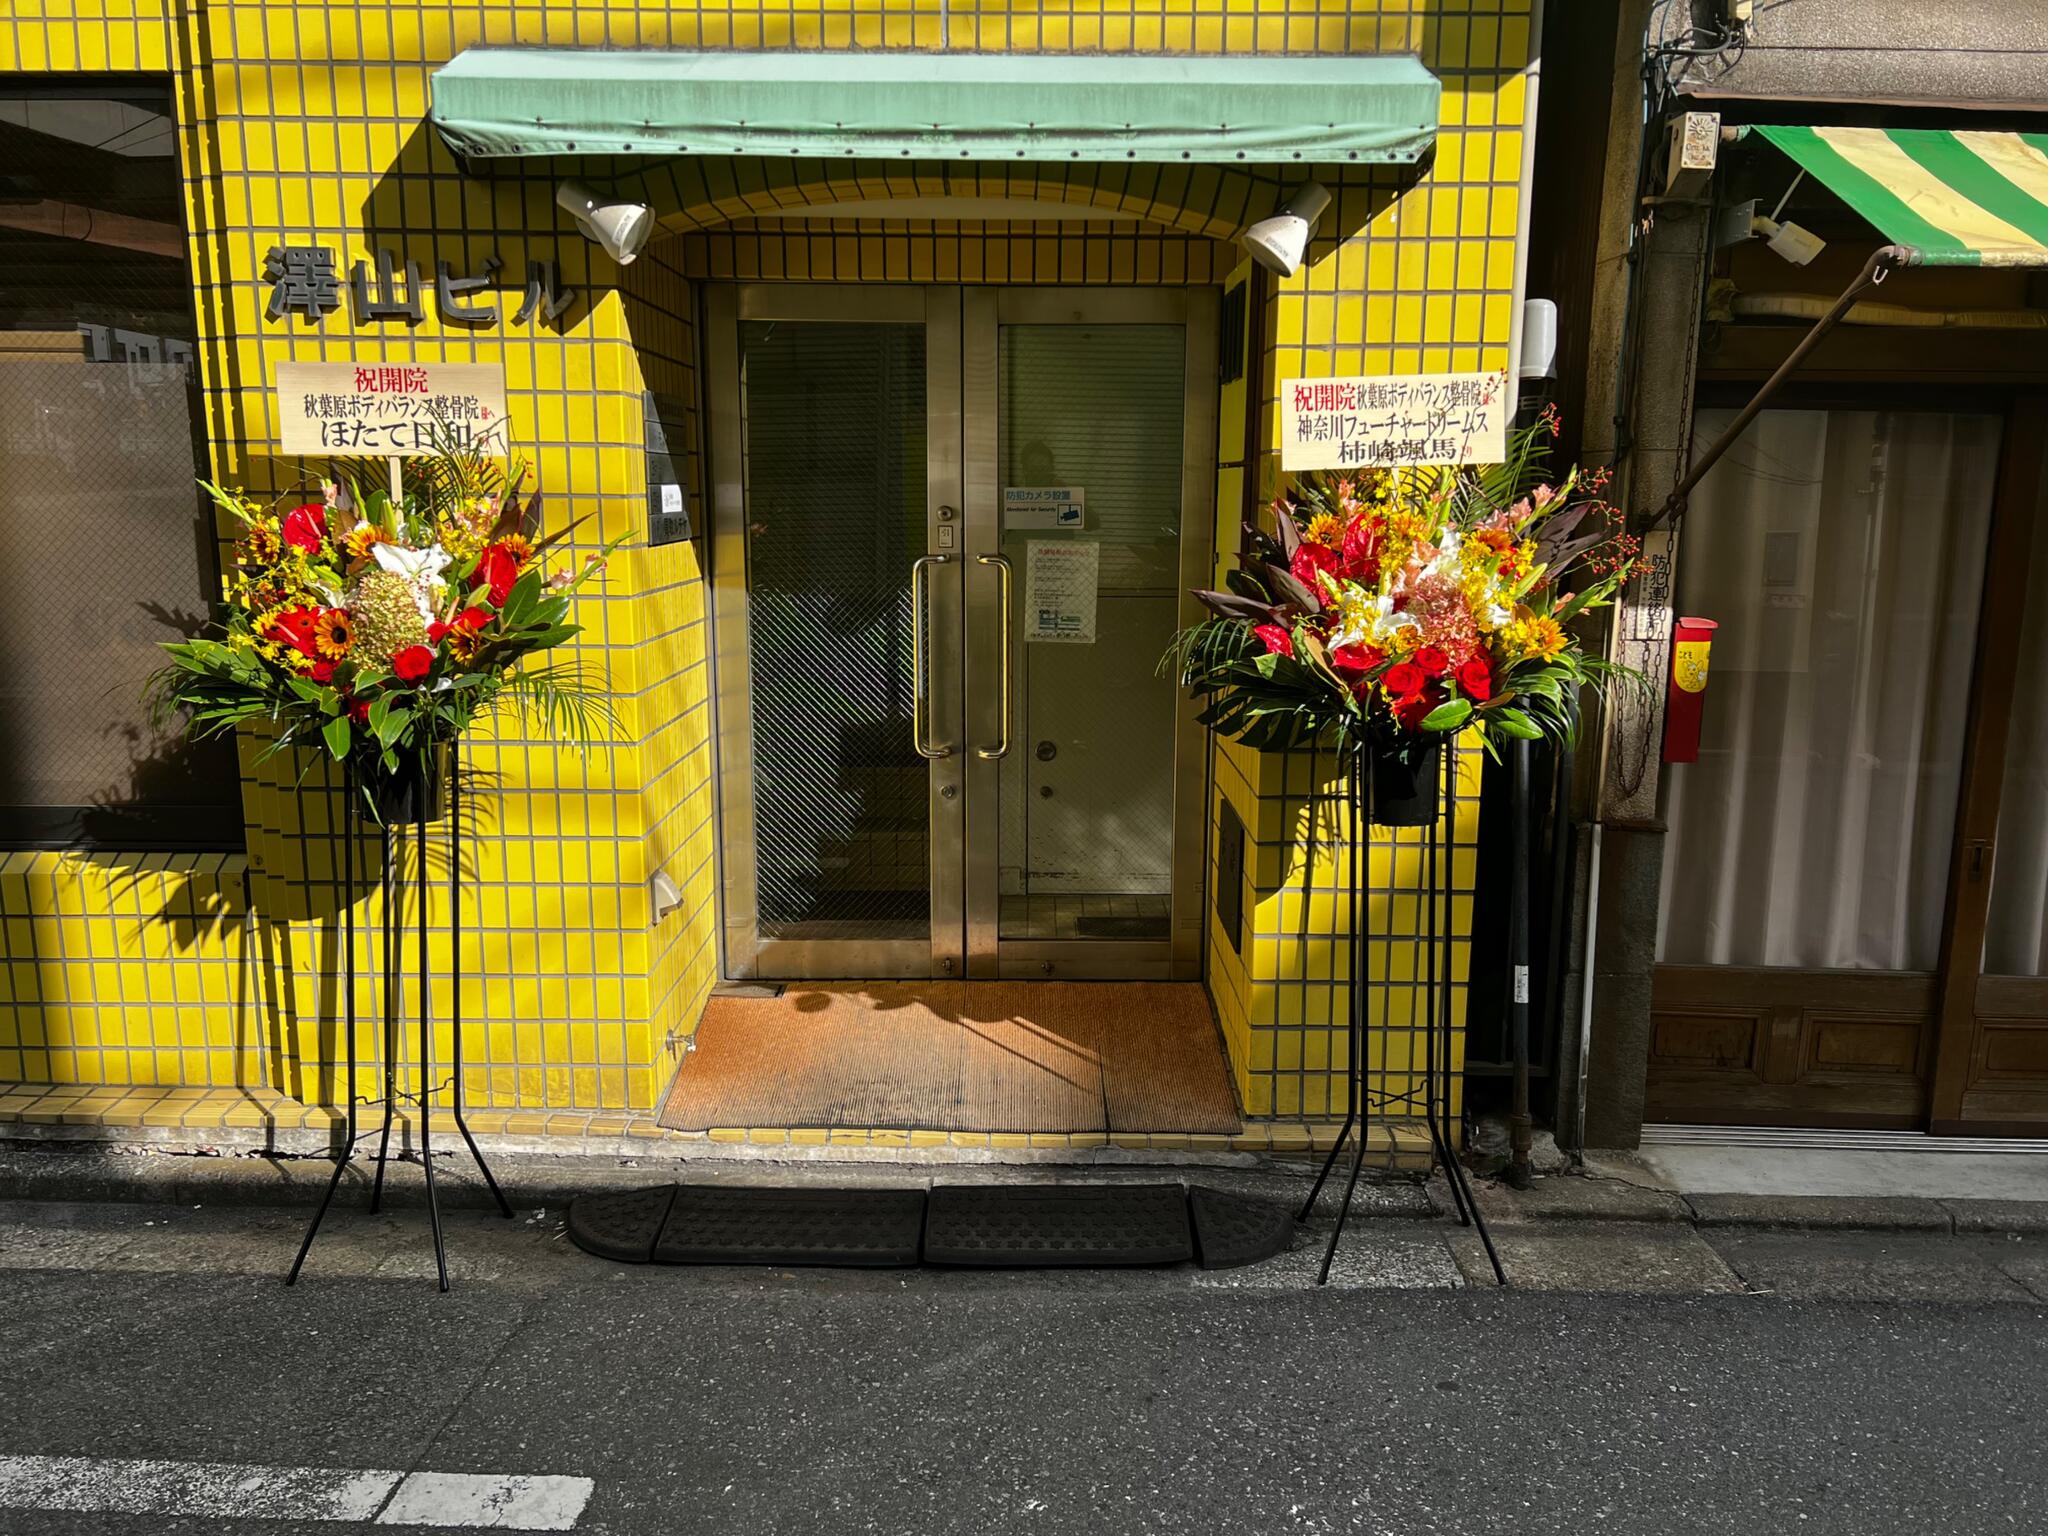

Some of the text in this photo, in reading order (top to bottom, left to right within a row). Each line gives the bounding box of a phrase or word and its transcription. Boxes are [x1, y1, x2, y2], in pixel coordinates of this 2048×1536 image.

[267, 246, 576, 321] 澤山ビル
[353, 366, 429, 394] 祝開院
[1293, 383, 1357, 412] 祝開院
[321, 418, 472, 450] ほたて日和
[1296, 410, 1489, 442] 神奈川フューチャードリームス
[1006, 490, 1071, 501] 防犯カメラ設置
